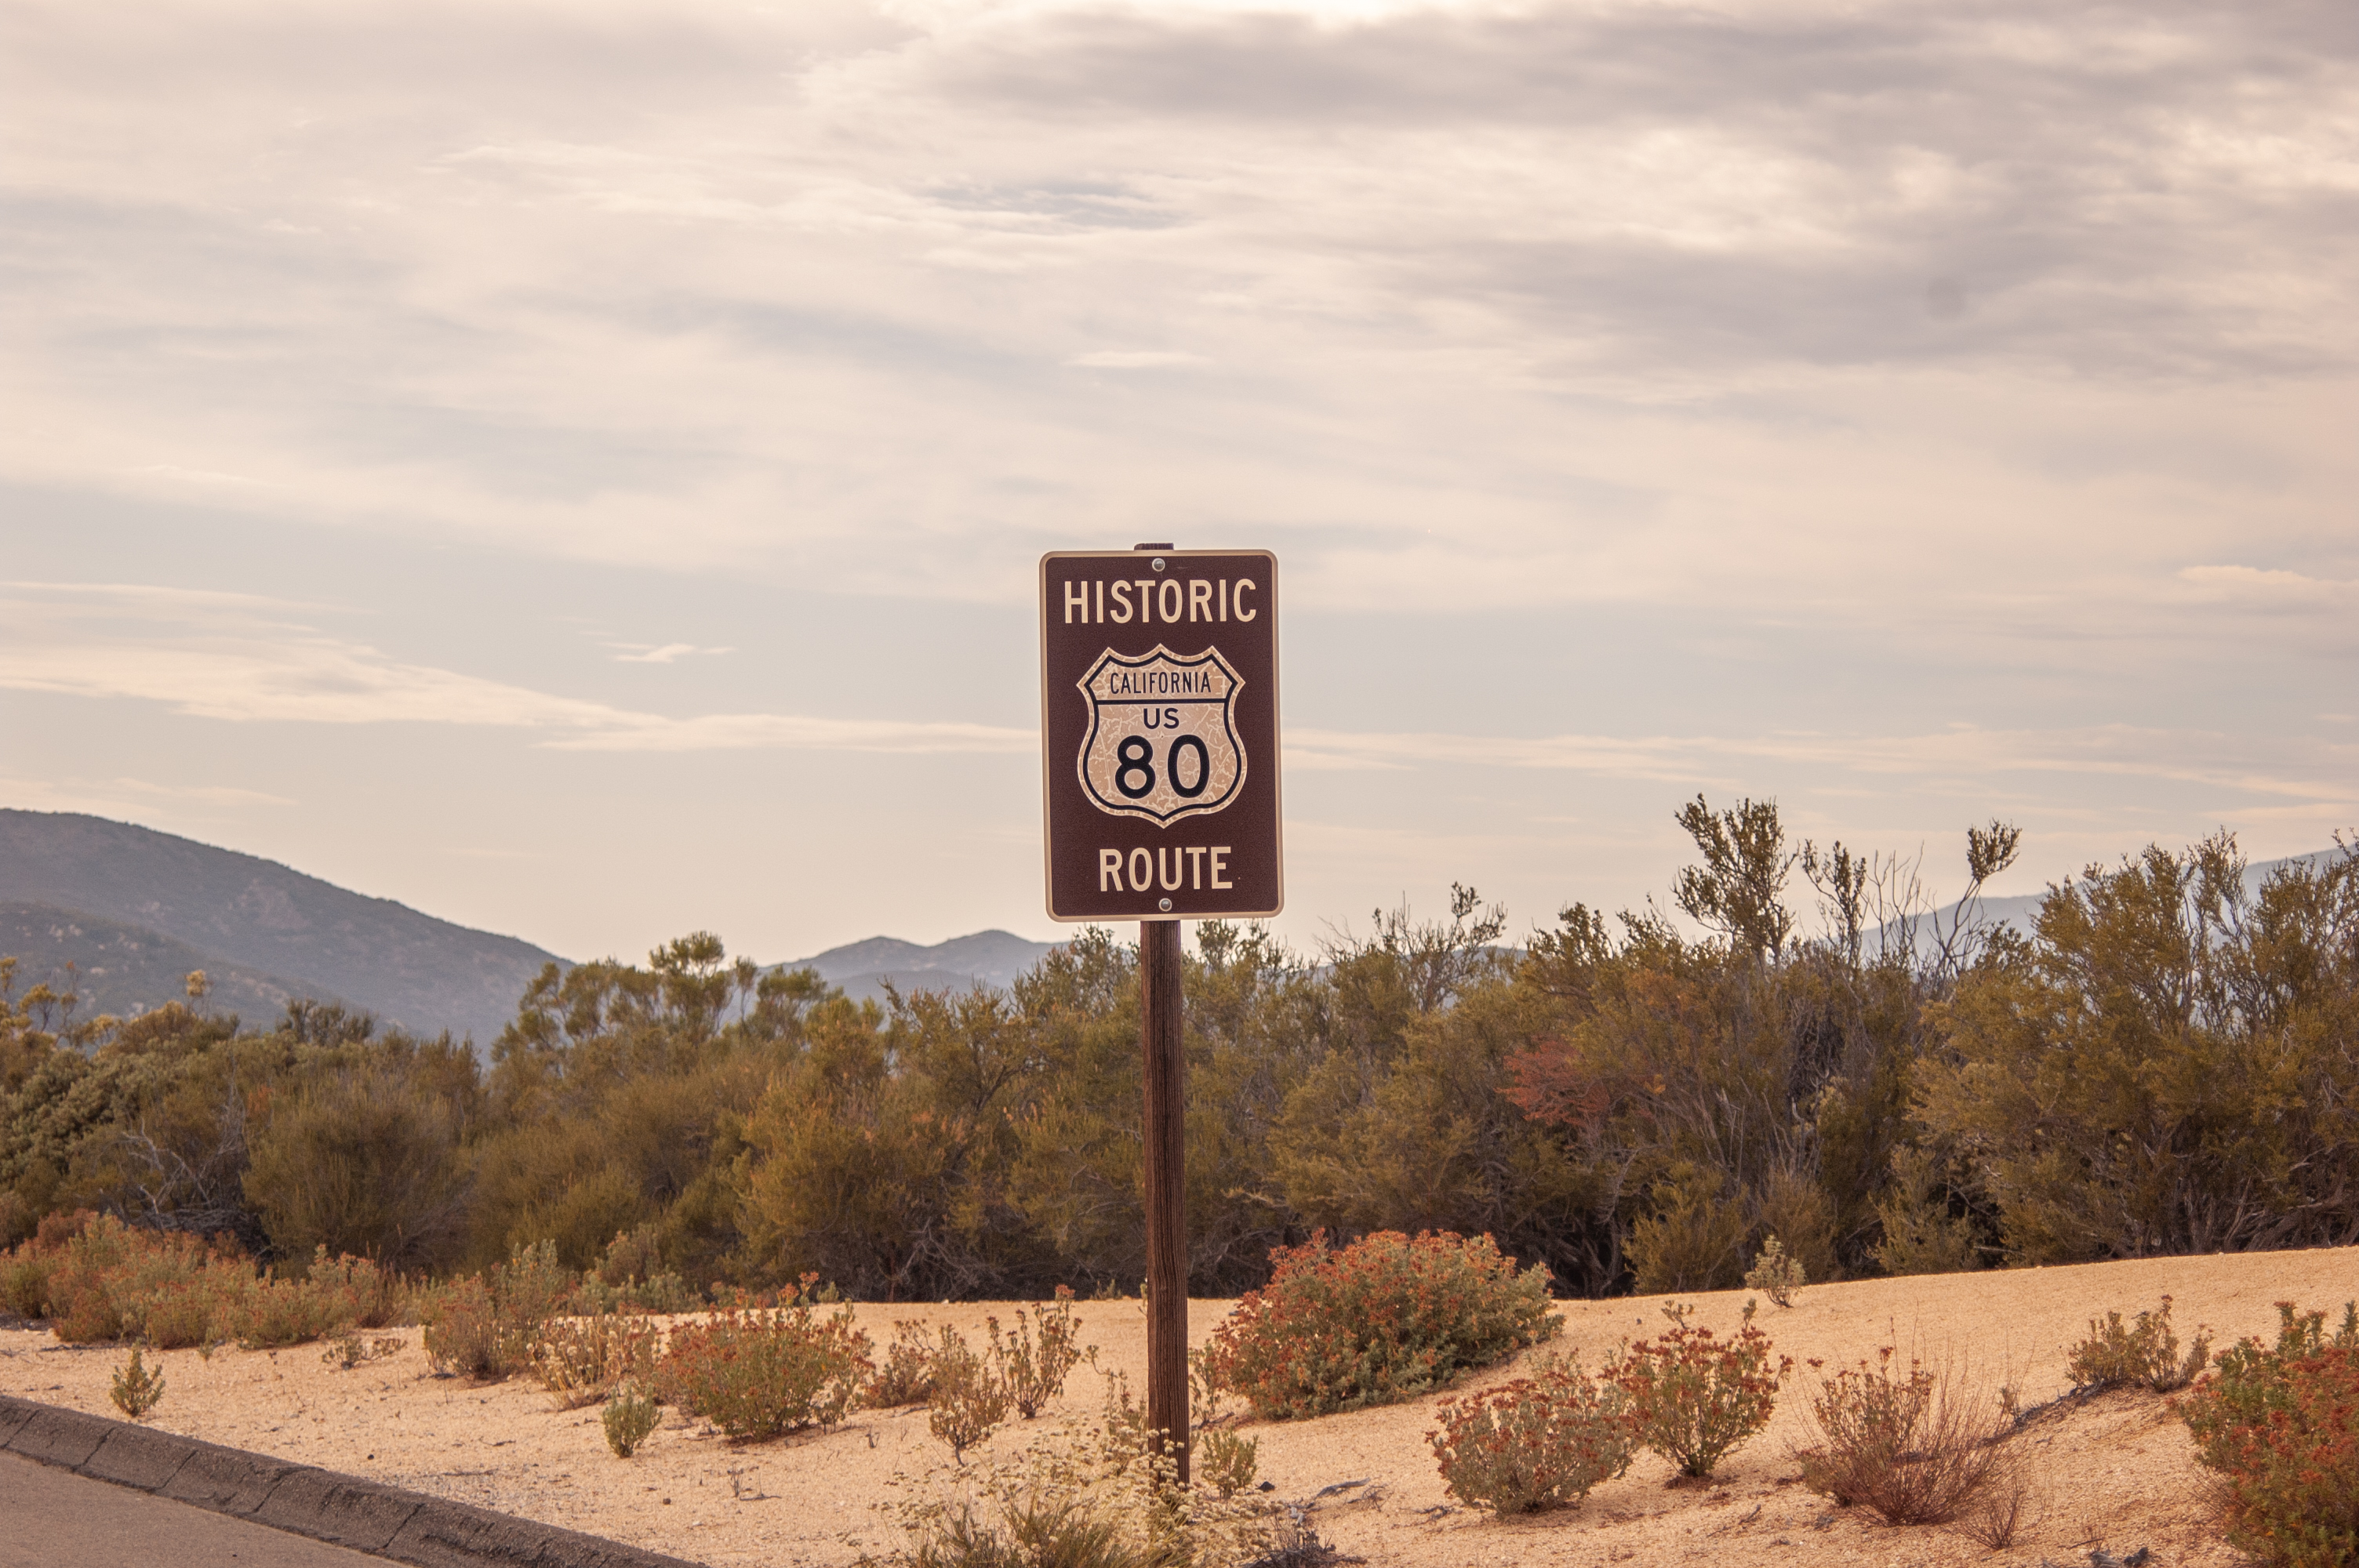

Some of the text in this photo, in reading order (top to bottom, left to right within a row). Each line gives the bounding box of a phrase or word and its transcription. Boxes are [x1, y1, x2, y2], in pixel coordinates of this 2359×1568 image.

[1064, 579, 1256, 623] HISTORIC
[1110, 672, 1212, 694] CALIFORNIA
[1143, 708, 1180, 730] US
[1114, 735, 1210, 800] 80
[1099, 847, 1233, 892] ROUTE
